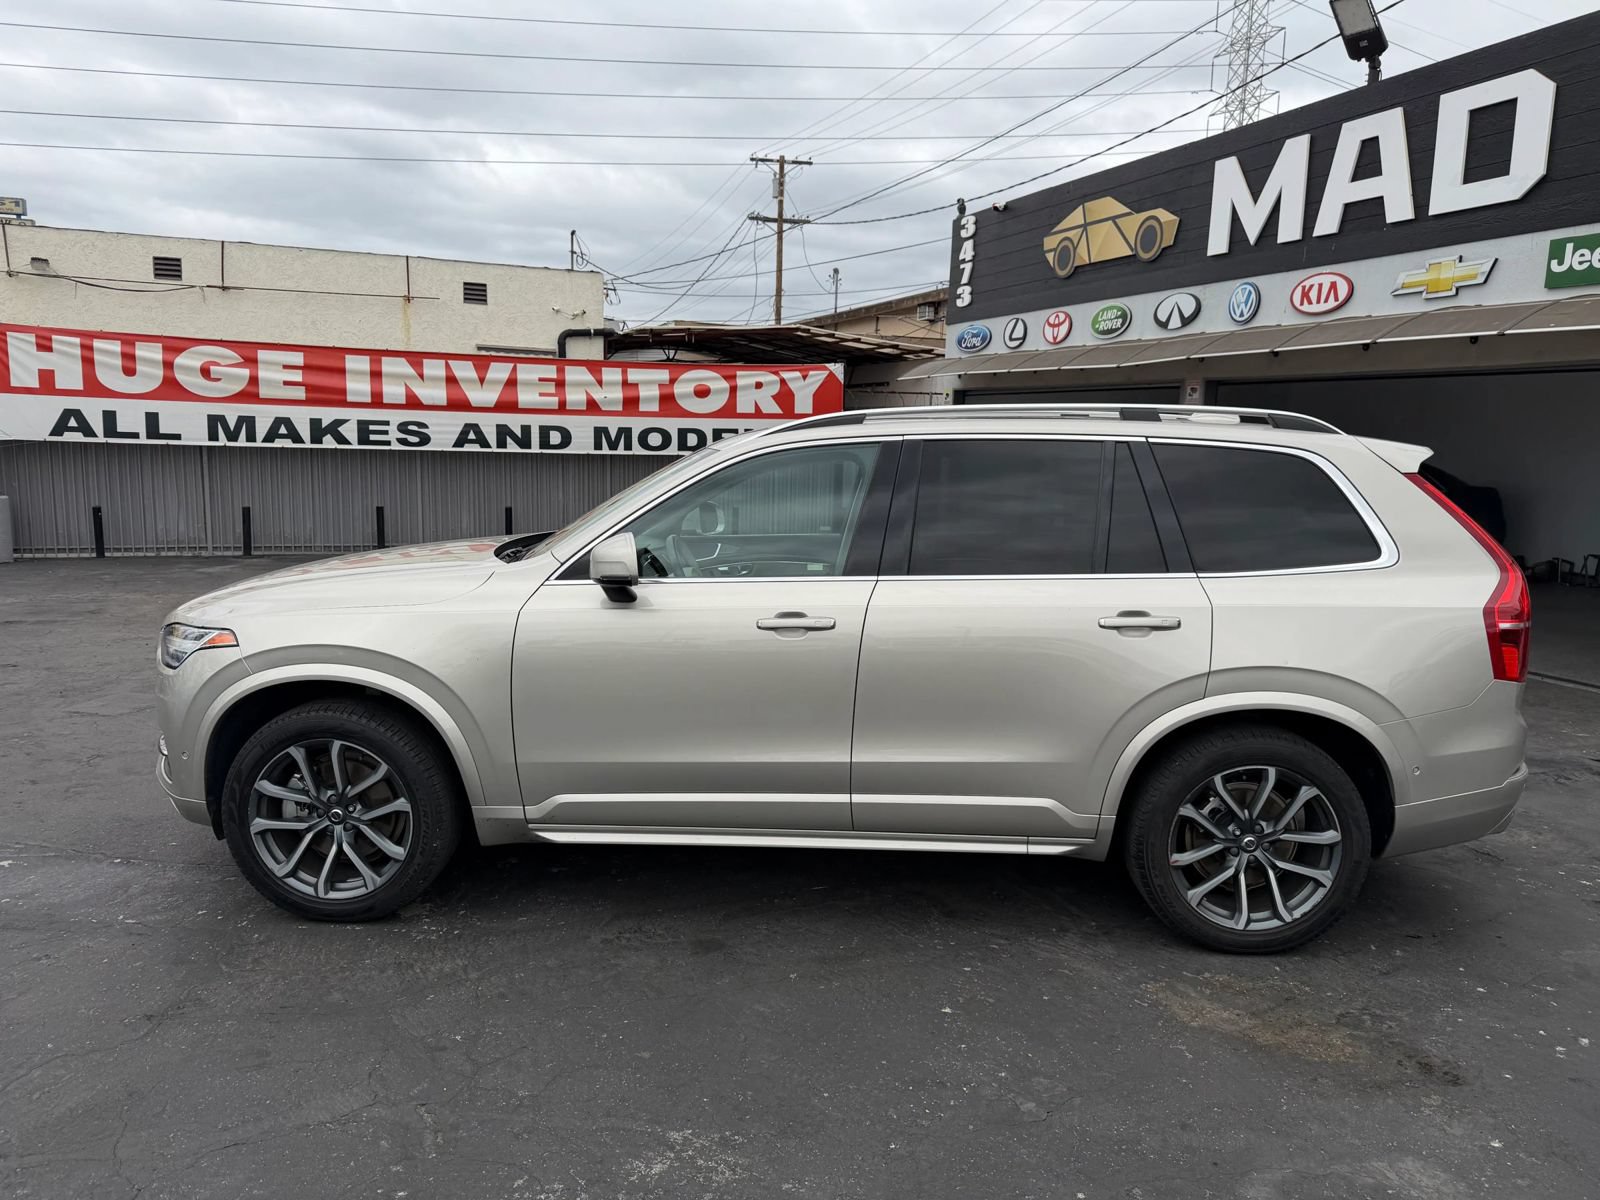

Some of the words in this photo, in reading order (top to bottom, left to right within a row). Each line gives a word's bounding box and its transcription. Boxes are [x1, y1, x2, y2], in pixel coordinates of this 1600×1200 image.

[1206, 68, 1557, 257] MAD
[956, 215, 977, 308] 3473
[1299, 281, 1340, 306] KIA
[1098, 309, 1118, 321] LAND
[1098, 318, 1122, 331] ROVER
[961, 329, 984, 348] Ford
[6, 331, 307, 401] HUGE
[345, 354, 830, 415] INVENTORY
[48, 407, 182, 441] ALL
[207, 413, 430, 448] MAKES
[451, 422, 573, 452] AND
[593, 426, 754, 452] MOD
